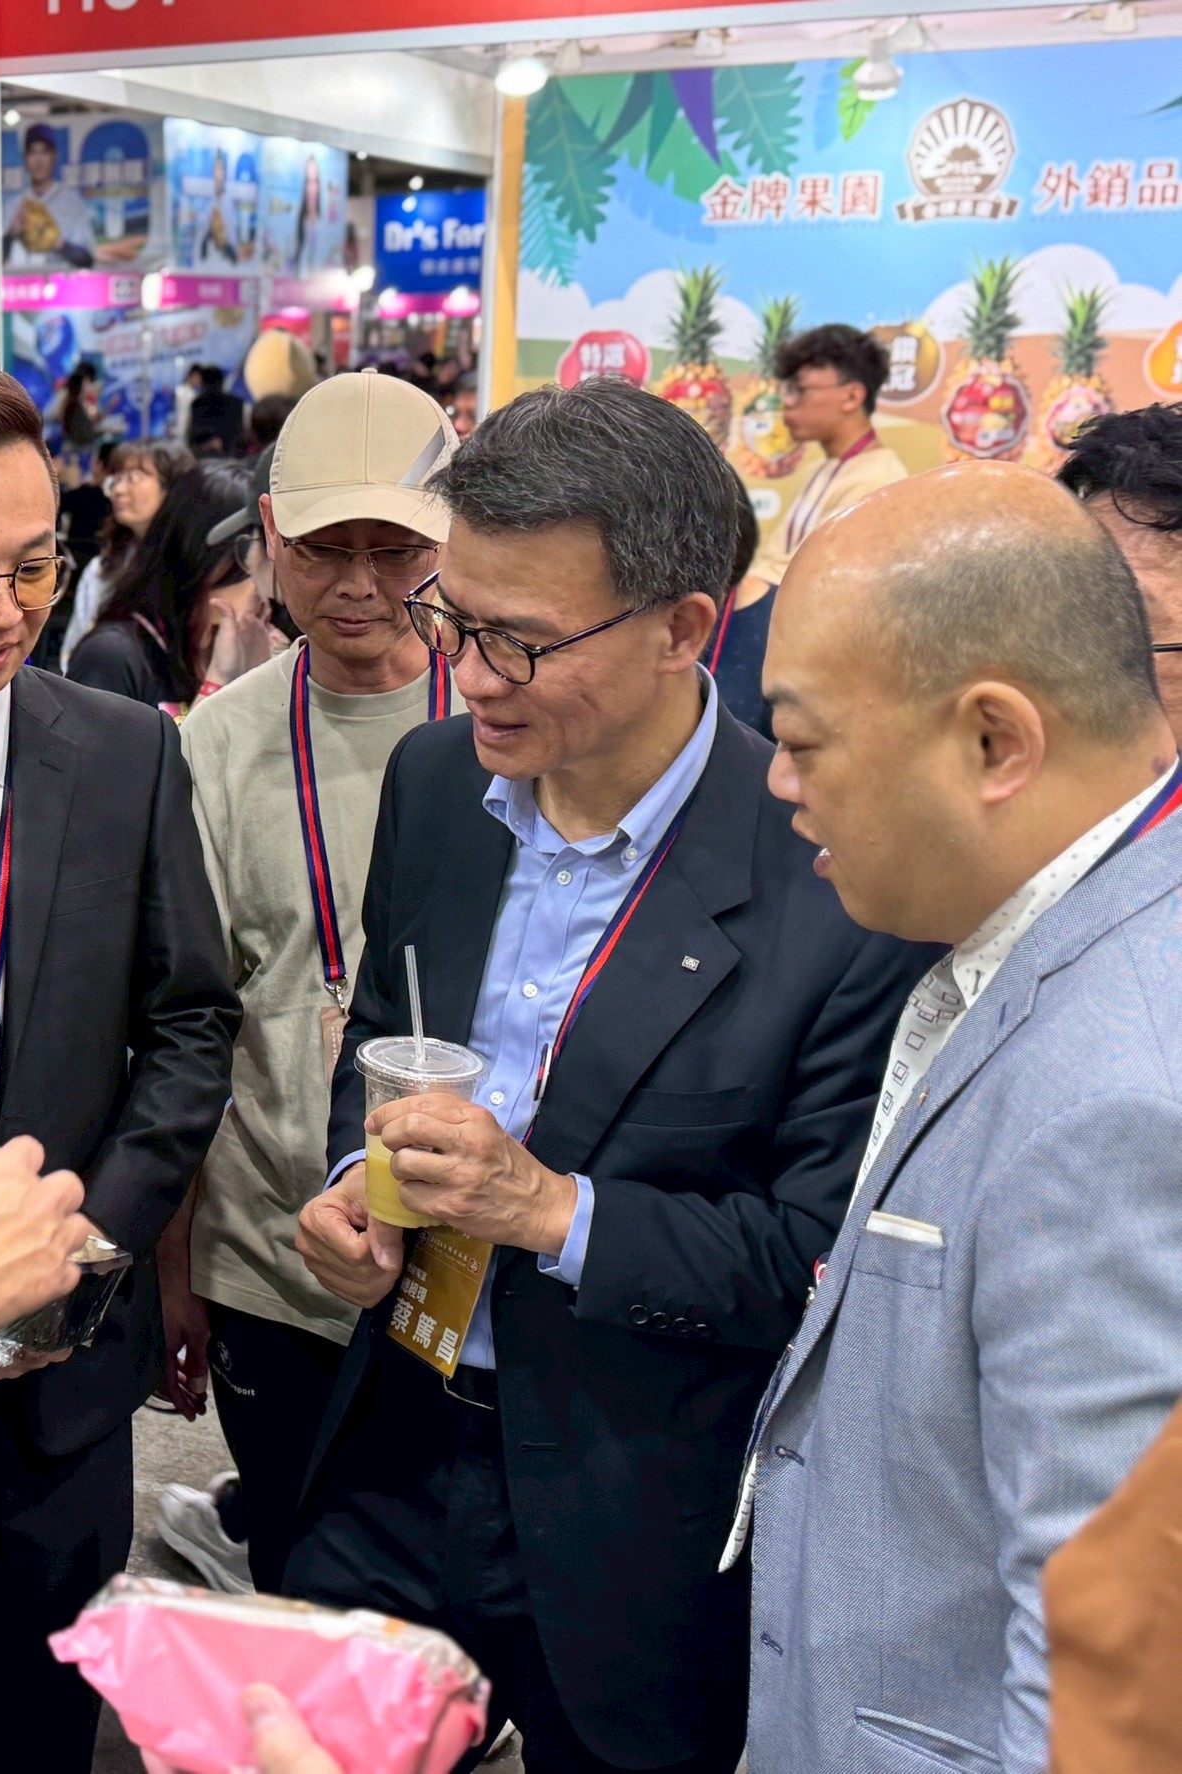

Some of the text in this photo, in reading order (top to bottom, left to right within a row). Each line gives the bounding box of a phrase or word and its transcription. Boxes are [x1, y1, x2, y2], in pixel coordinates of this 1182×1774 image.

[704, 173, 882, 222] 金牌果園
[1038, 162, 1181, 209] 外銷品
[383, 219, 439, 252] Dr's
[390, 1297, 459, 1365] 蔡篤昌
